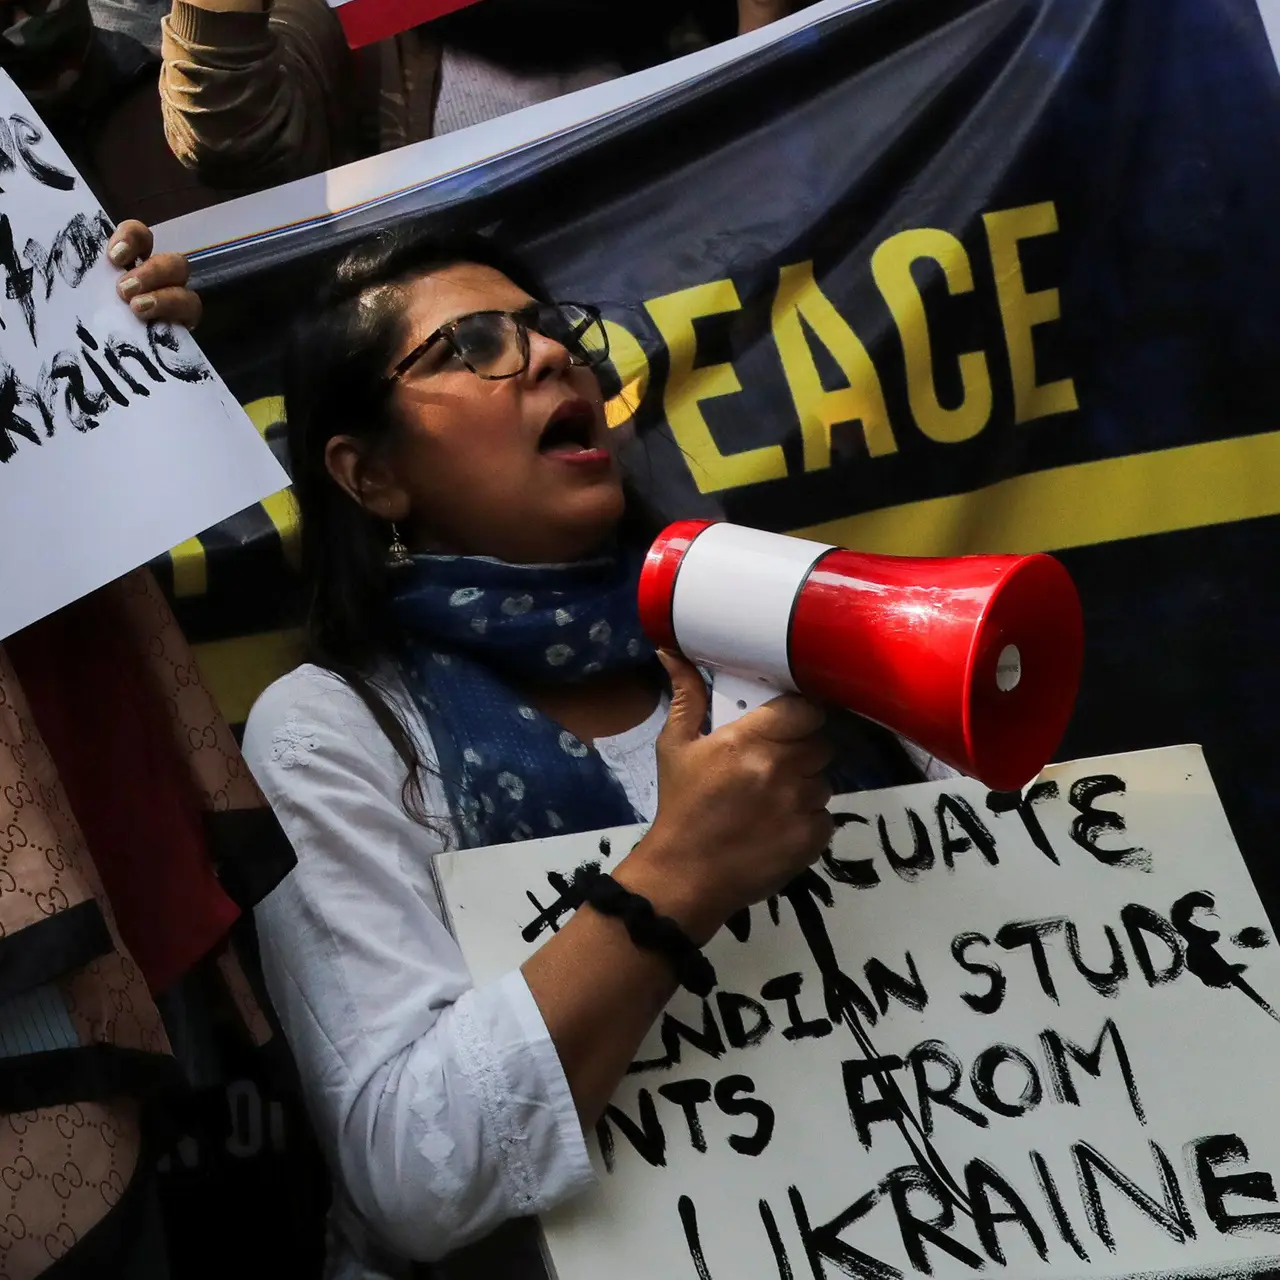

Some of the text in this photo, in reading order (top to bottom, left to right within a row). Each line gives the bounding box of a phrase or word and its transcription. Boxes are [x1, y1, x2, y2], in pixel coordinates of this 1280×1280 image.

[629, 950, 928, 1073] NDIAN
[596, 1018, 1146, 1172] NTS FROM
[677, 1135, 1280, 1280] UKRAINE
